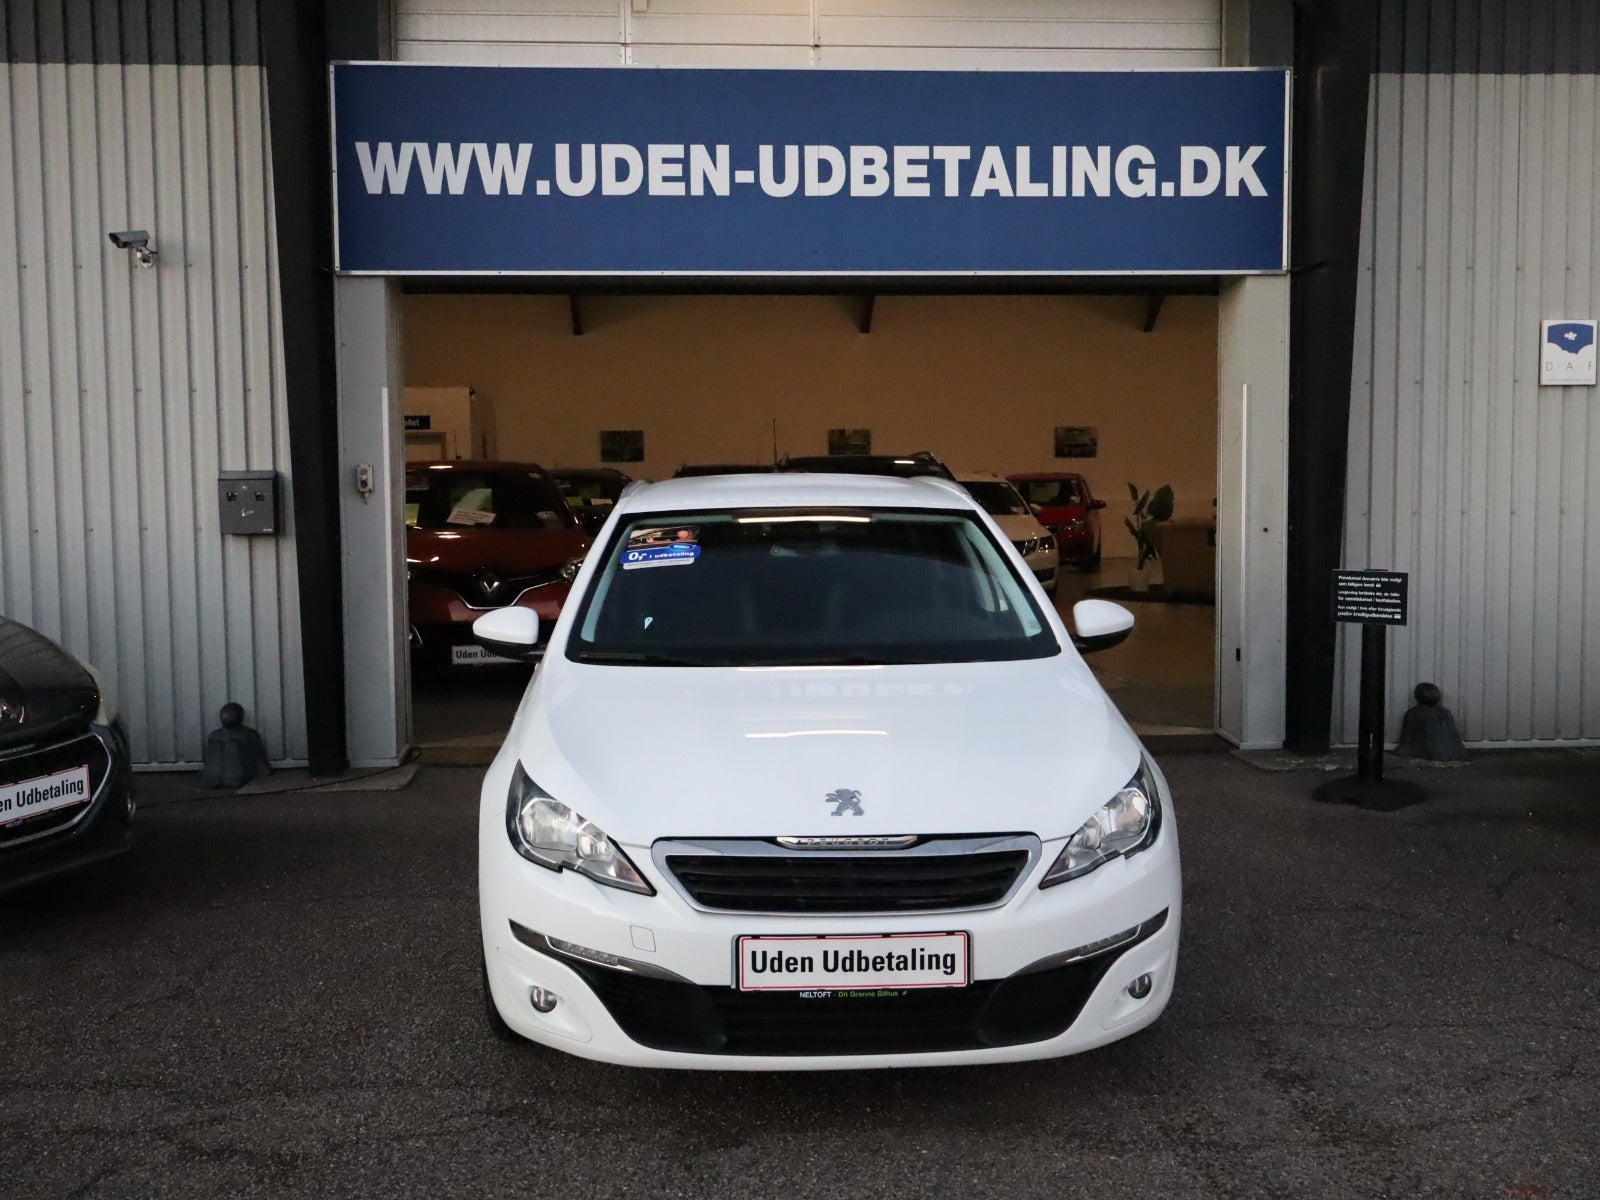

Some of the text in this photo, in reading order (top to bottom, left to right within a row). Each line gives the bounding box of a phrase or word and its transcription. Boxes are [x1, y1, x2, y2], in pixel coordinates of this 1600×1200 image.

[355, 142, 1269, 198] WWW.UDEN-UDBETALING.DK
[456, 650, 478, 659] Uden
[0, 779, 84, 813] en Udbetaling
[751, 948, 956, 976] Uden Udbetaling
